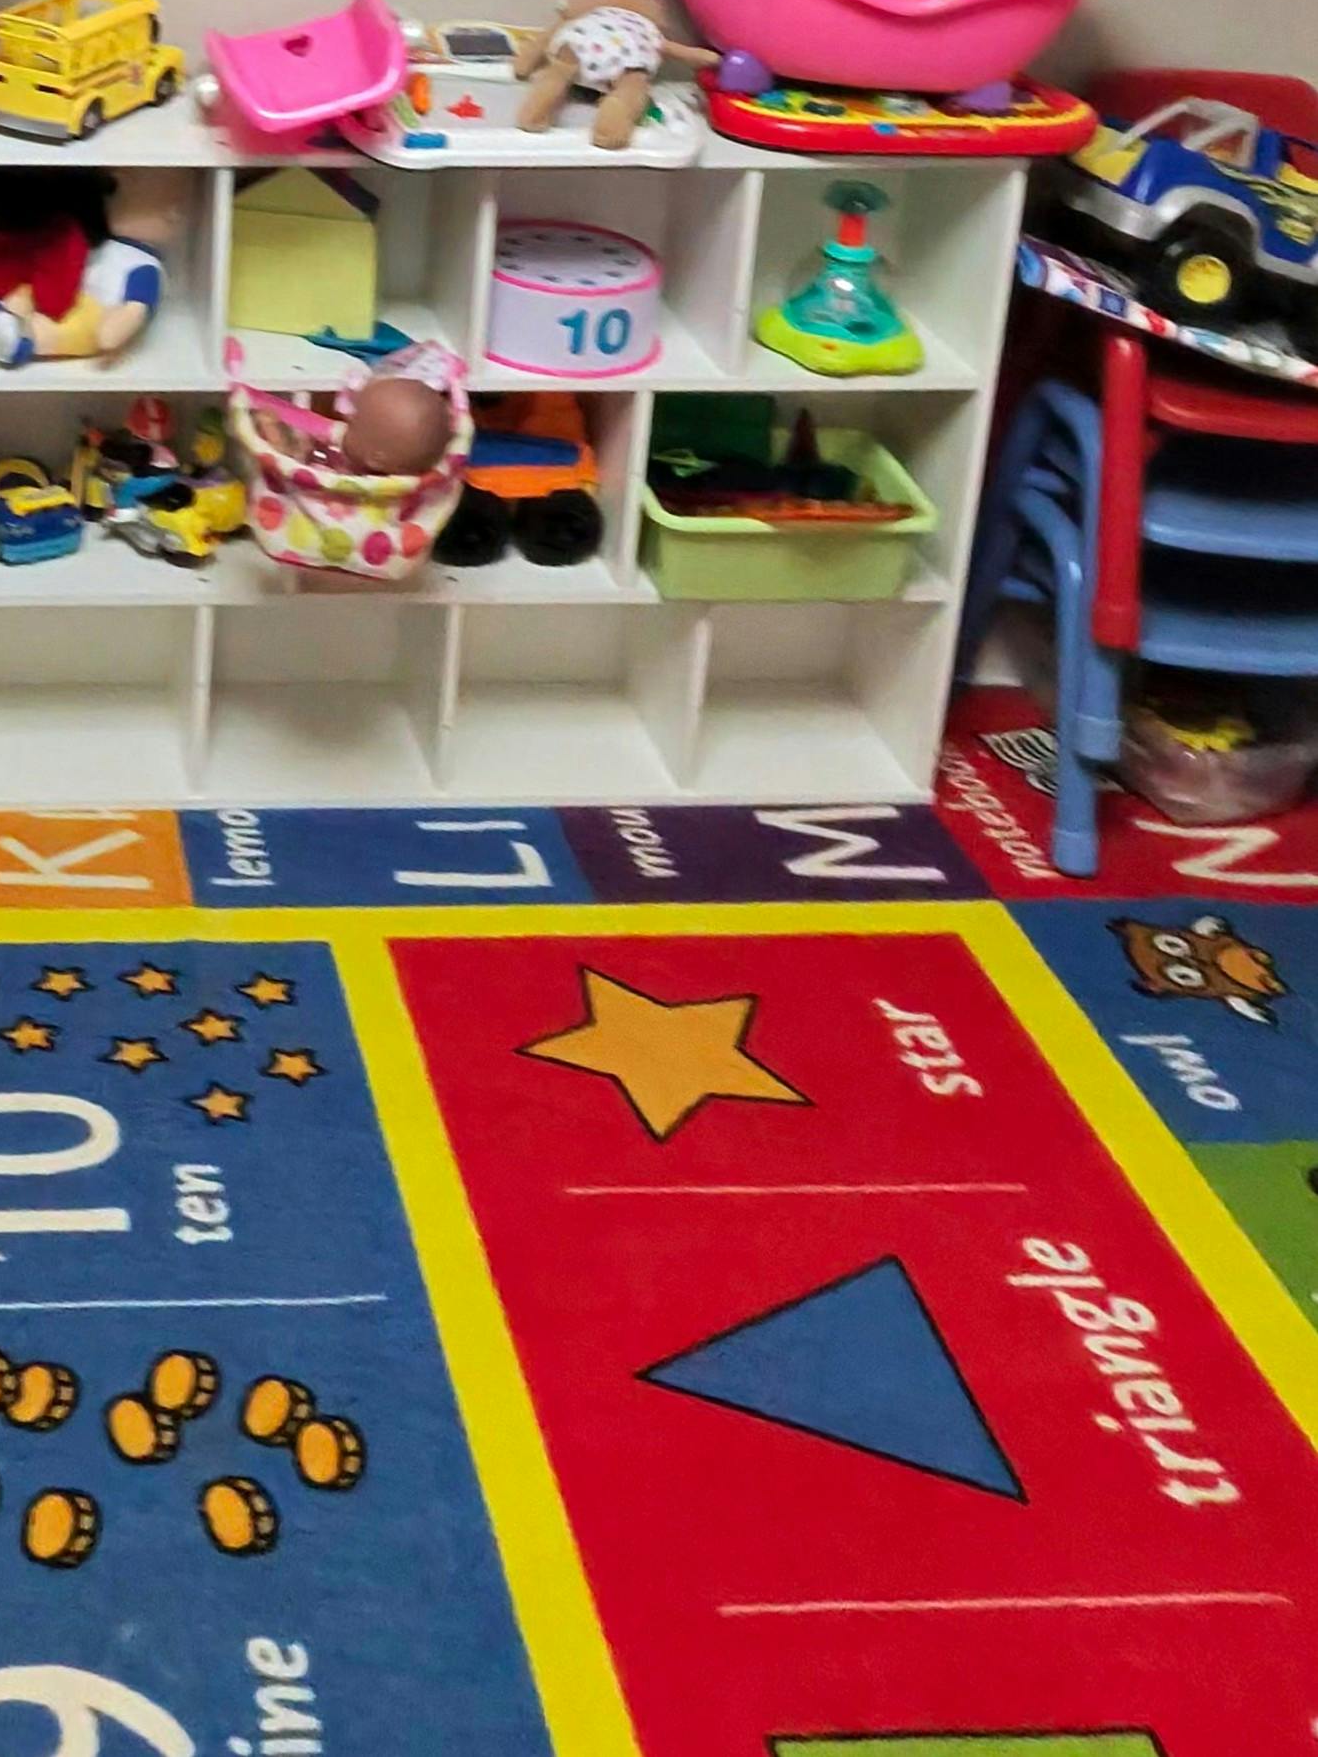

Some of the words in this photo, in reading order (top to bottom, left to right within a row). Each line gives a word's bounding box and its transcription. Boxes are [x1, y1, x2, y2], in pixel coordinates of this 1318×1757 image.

[558, 307, 632, 356] 10
[211, 808, 276, 888] lemo
[871, 997, 984, 1098] star
[1119, 1033, 1243, 1112] owl
[173, 1163, 234, 1245] ten
[1005, 1236, 1242, 1507] triangle
